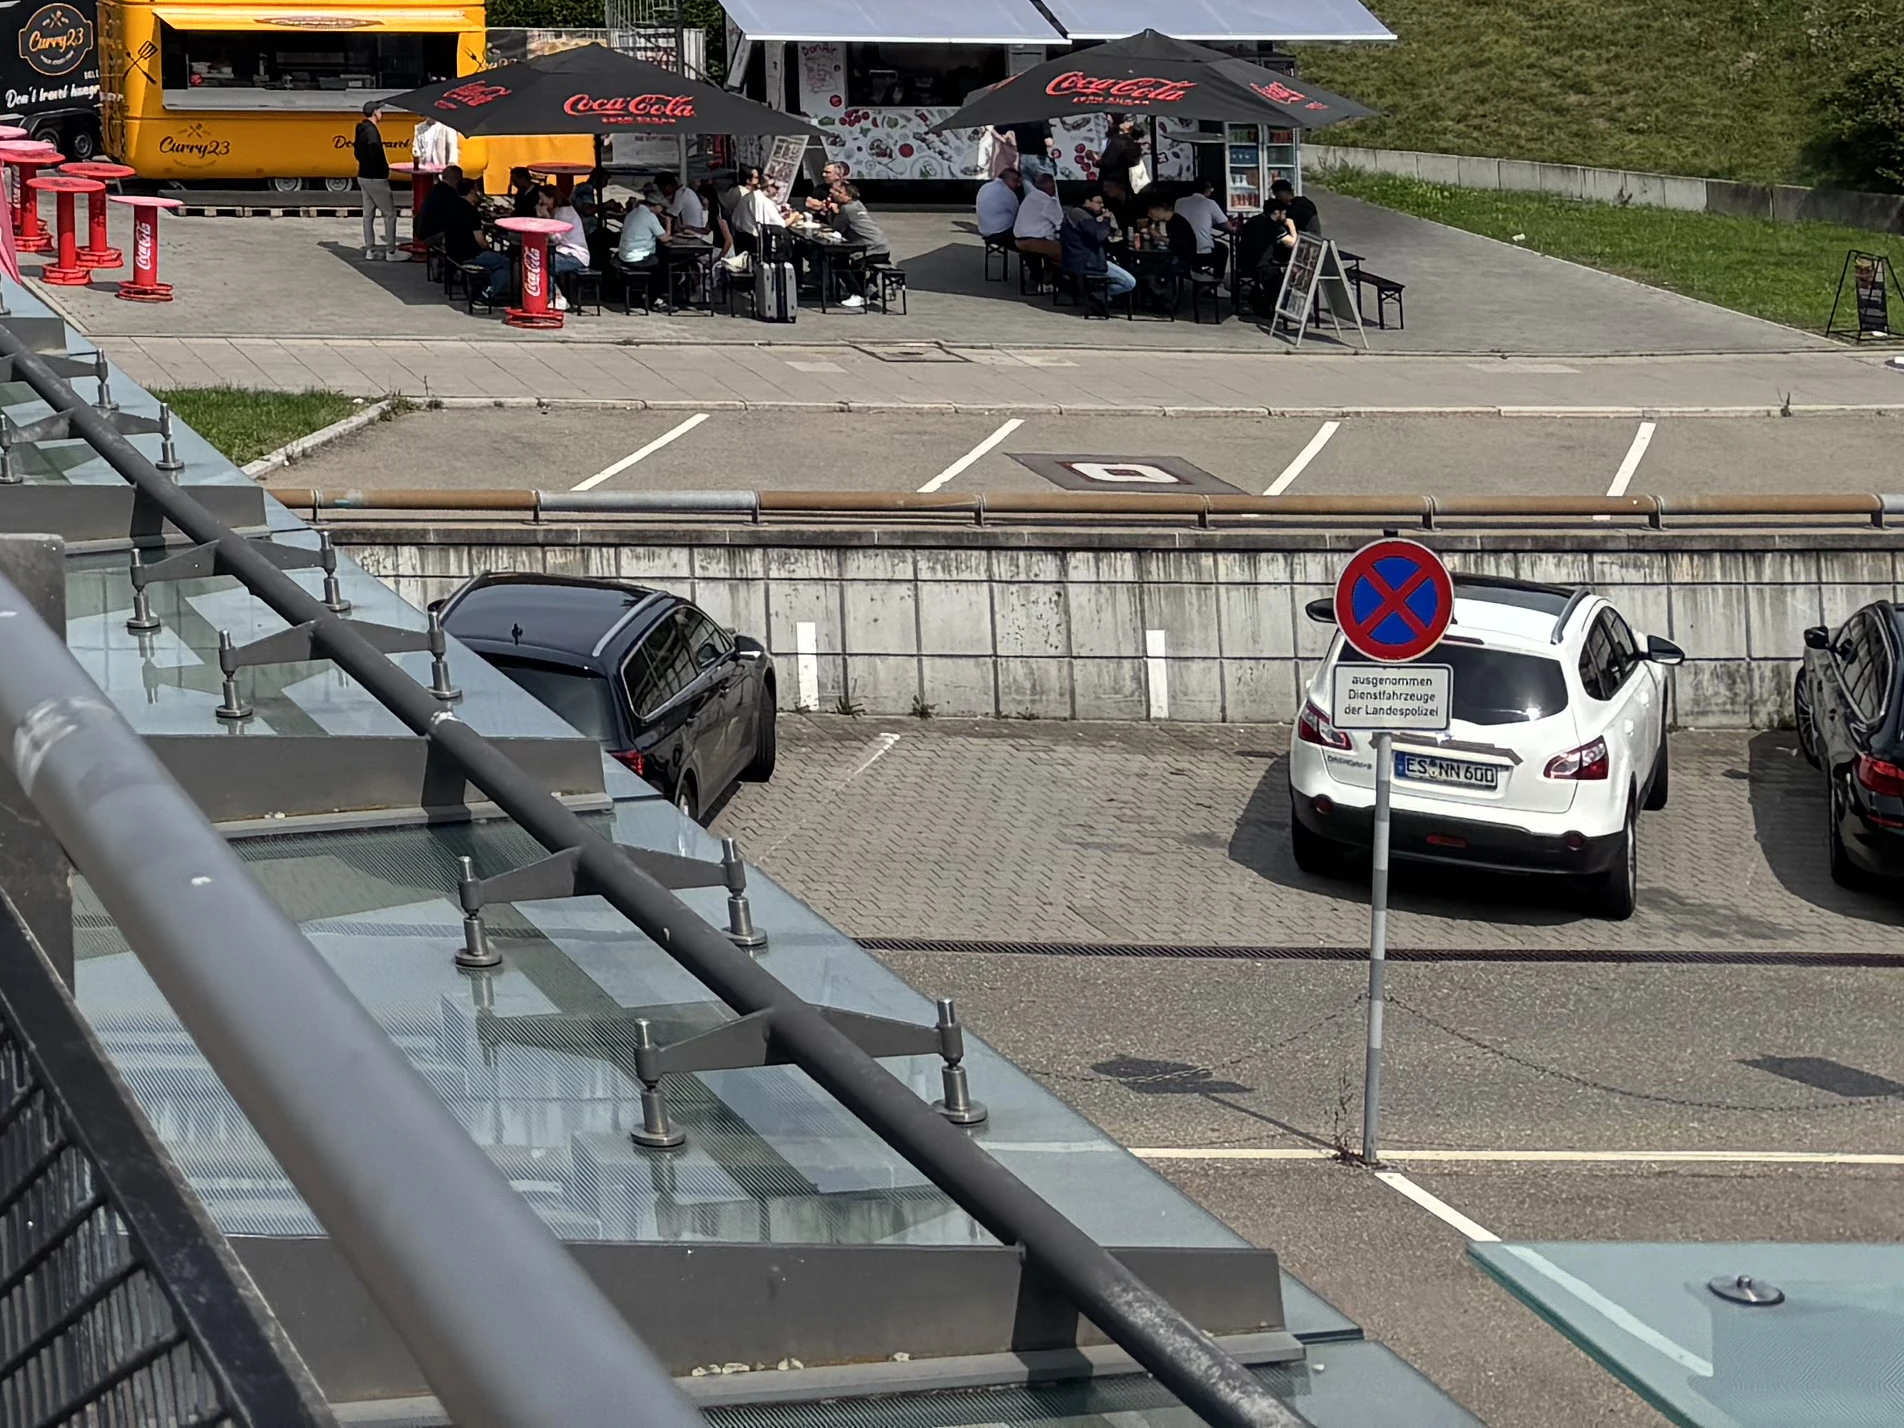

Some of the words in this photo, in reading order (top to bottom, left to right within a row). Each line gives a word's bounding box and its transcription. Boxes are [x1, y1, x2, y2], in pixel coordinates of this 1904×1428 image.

[29, 27, 85, 53] Curry23
[1045, 71, 1198, 102] Coca-Cola
[563, 93, 697, 117] Coca-Cola
[159, 136, 231, 159] Curry23
[1352, 676, 1433, 688] ausgenommen
[1348, 689, 1436, 704] Dienstfahrzeuge
[1344, 704, 1362, 715] der
[1365, 705, 1439, 718] Landespolizei
[1406, 757, 1427, 775] ES
[1438, 763, 1461, 780] NN
[1464, 767, 1495, 783] 600
